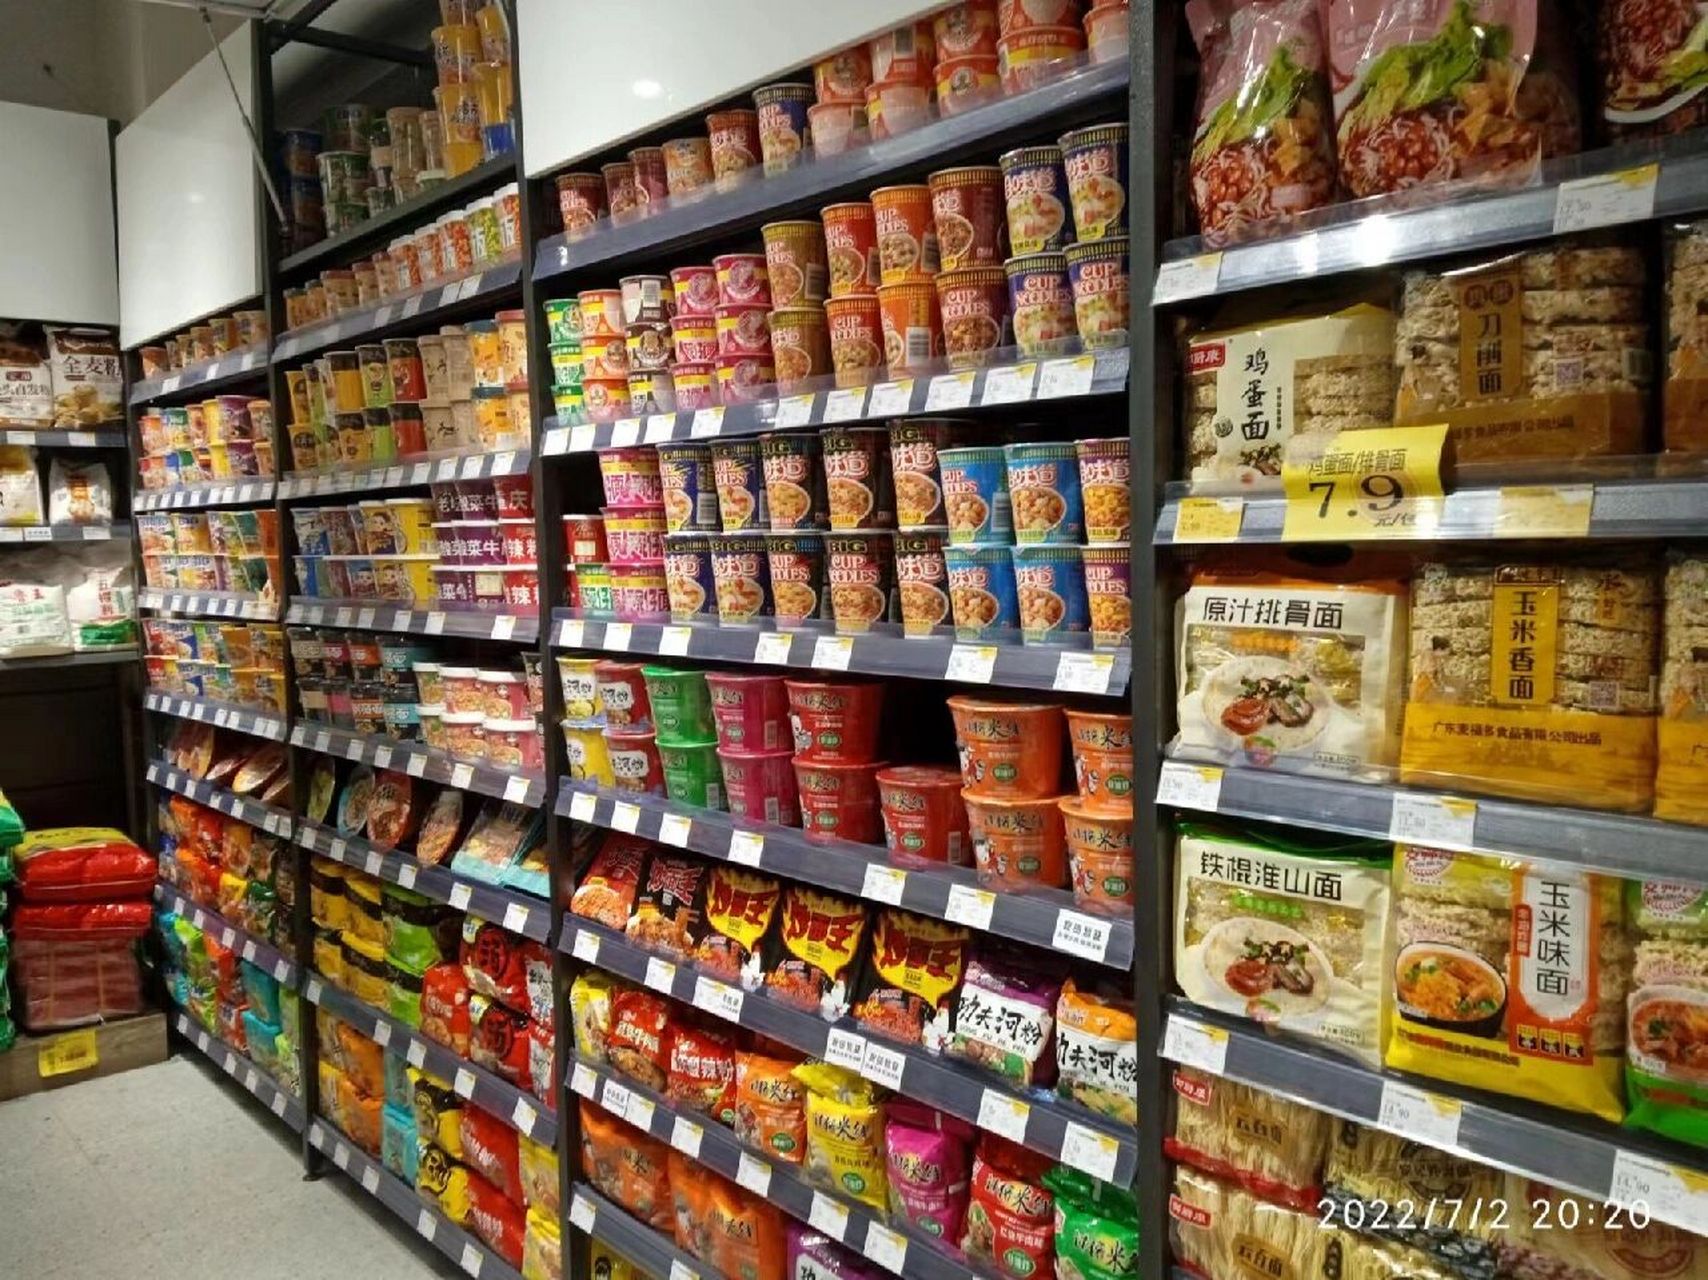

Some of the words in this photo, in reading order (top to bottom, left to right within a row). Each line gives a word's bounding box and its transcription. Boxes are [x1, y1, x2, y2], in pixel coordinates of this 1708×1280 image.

[1240, 347, 1270, 441] 鸡蛋面
[1202, 596, 1344, 629] 原汁排骨面
[1508, 591, 1538, 700] 玉米香面
[1200, 850, 1342, 902] 铁棍淮山面
[1536, 880, 1572, 996] 玉米味面
[957, 995, 1044, 1046] 功夫河粉
